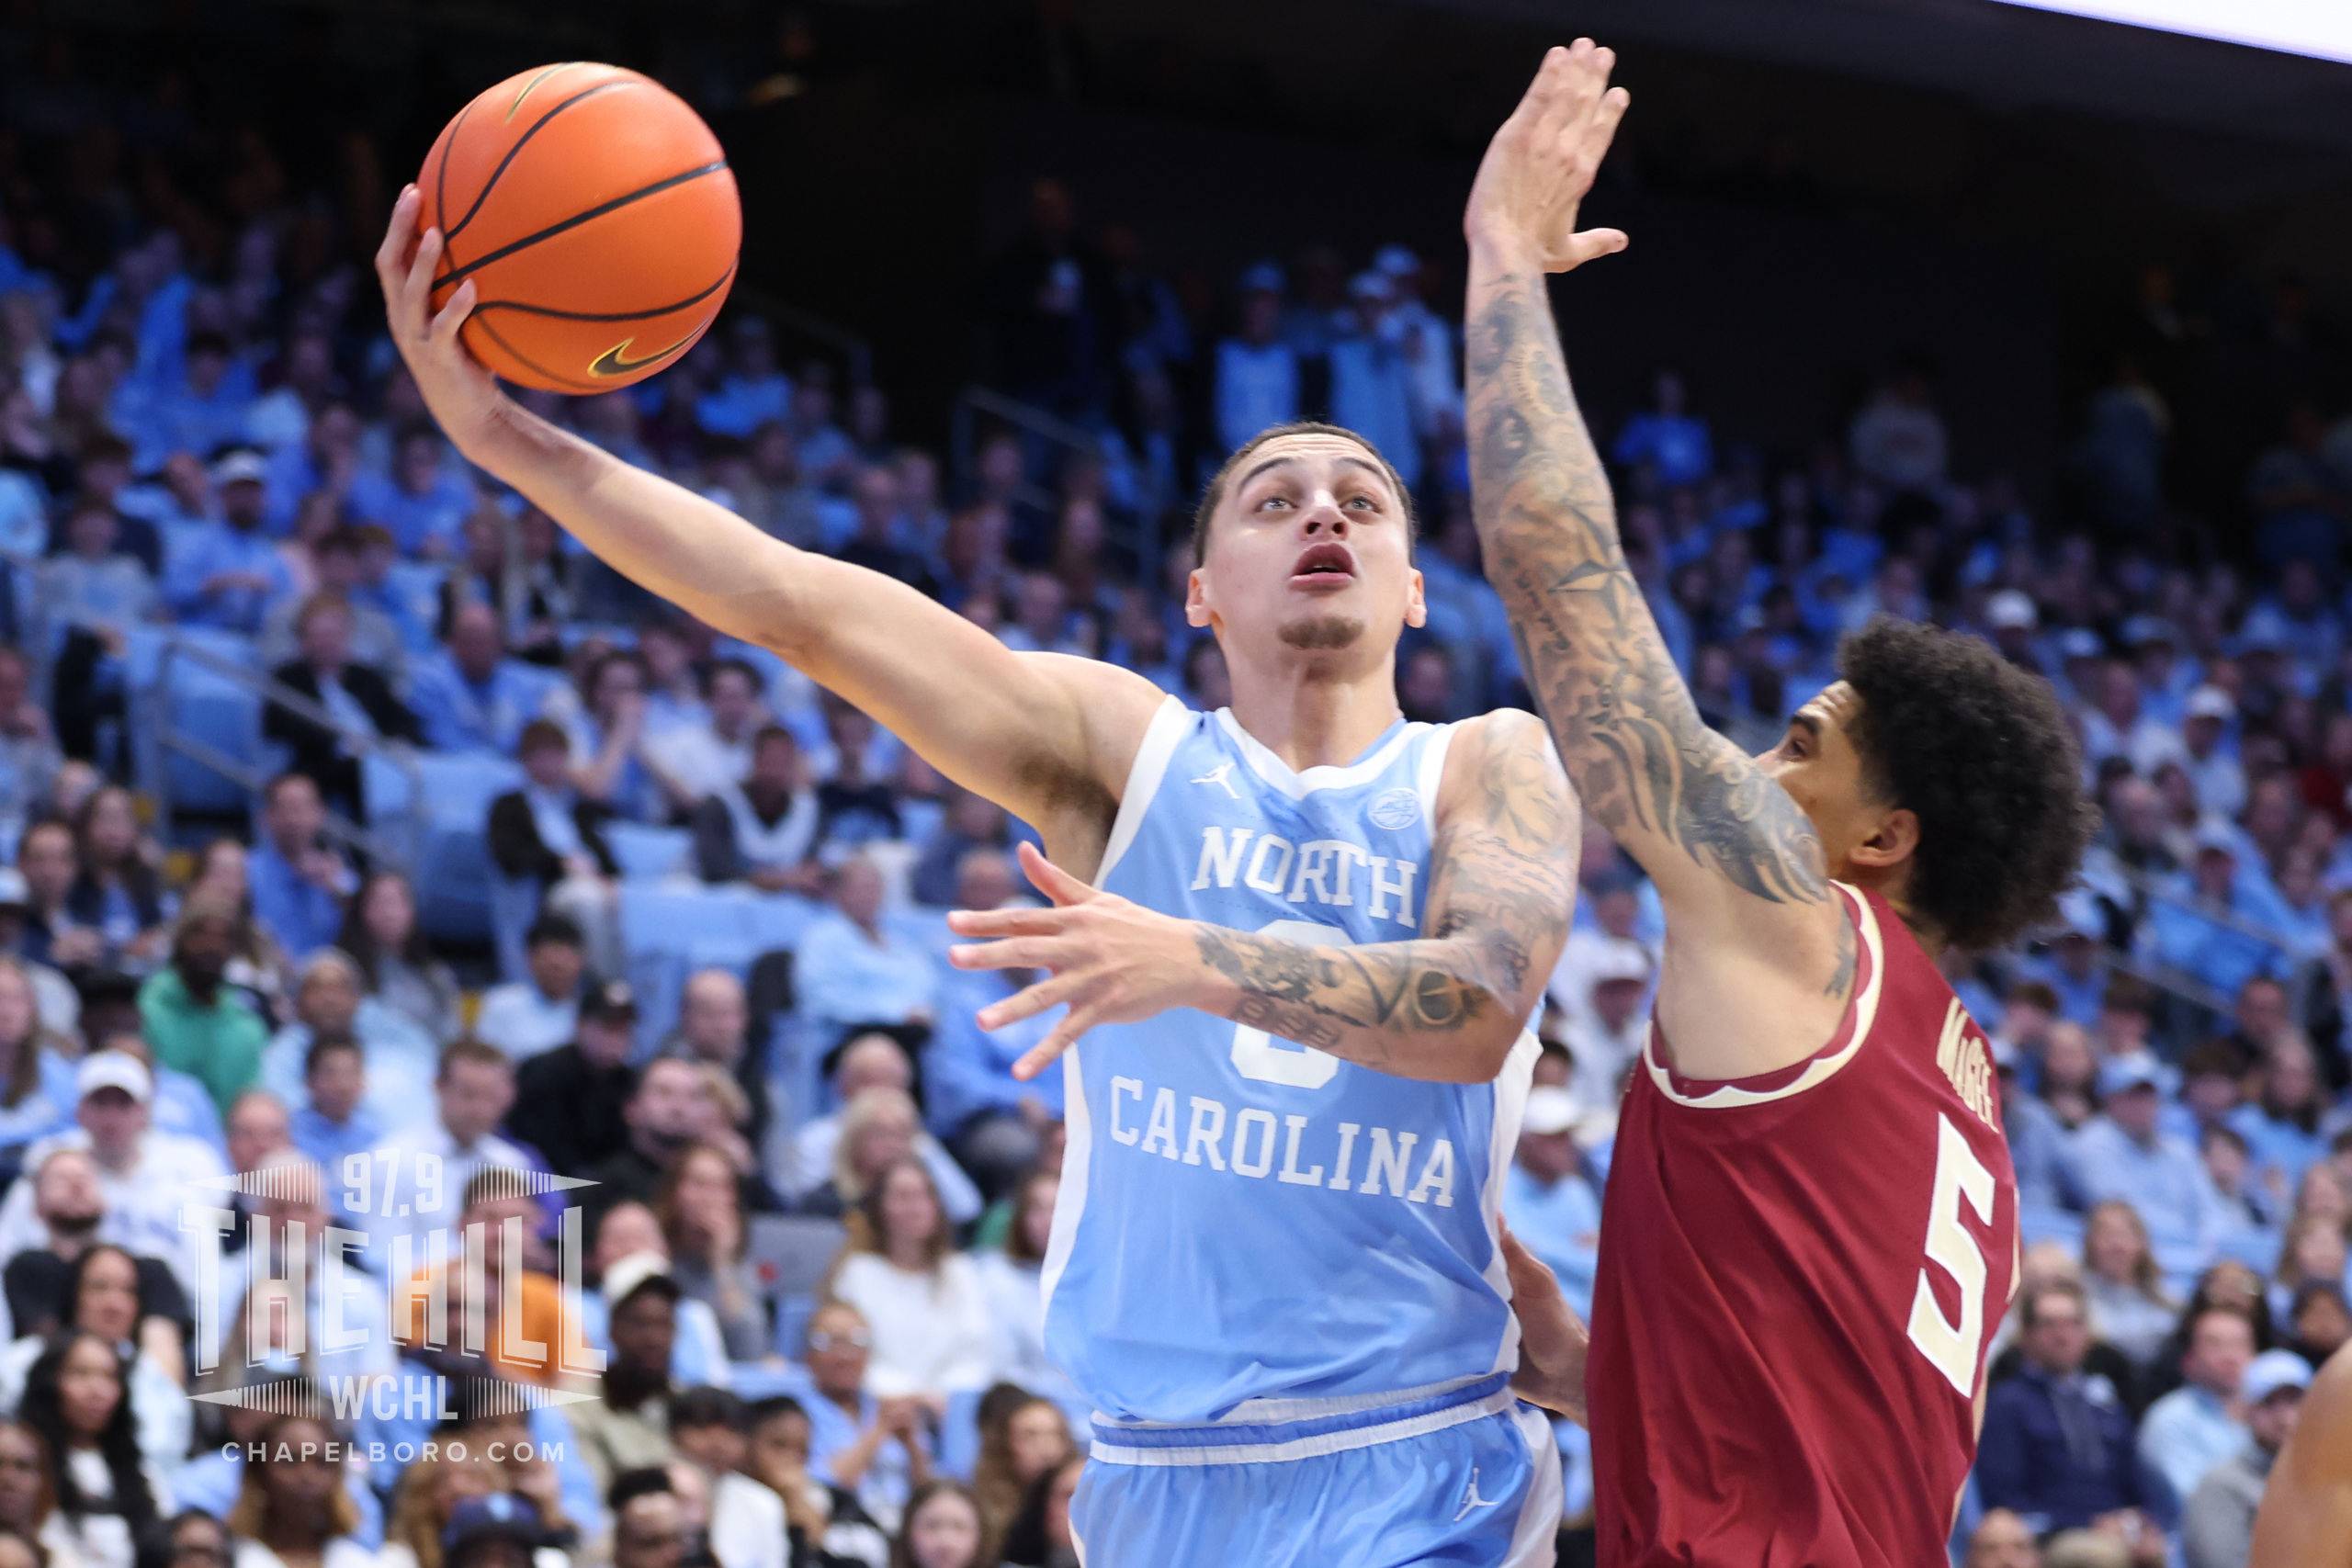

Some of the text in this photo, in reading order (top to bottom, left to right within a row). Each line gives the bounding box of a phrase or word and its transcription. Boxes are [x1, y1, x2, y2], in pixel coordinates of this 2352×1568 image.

[1190, 826, 1418, 929] NORTH
[1110, 1075, 1454, 1208] CAROLINA
[1906, 1111, 1996, 1399] 5
